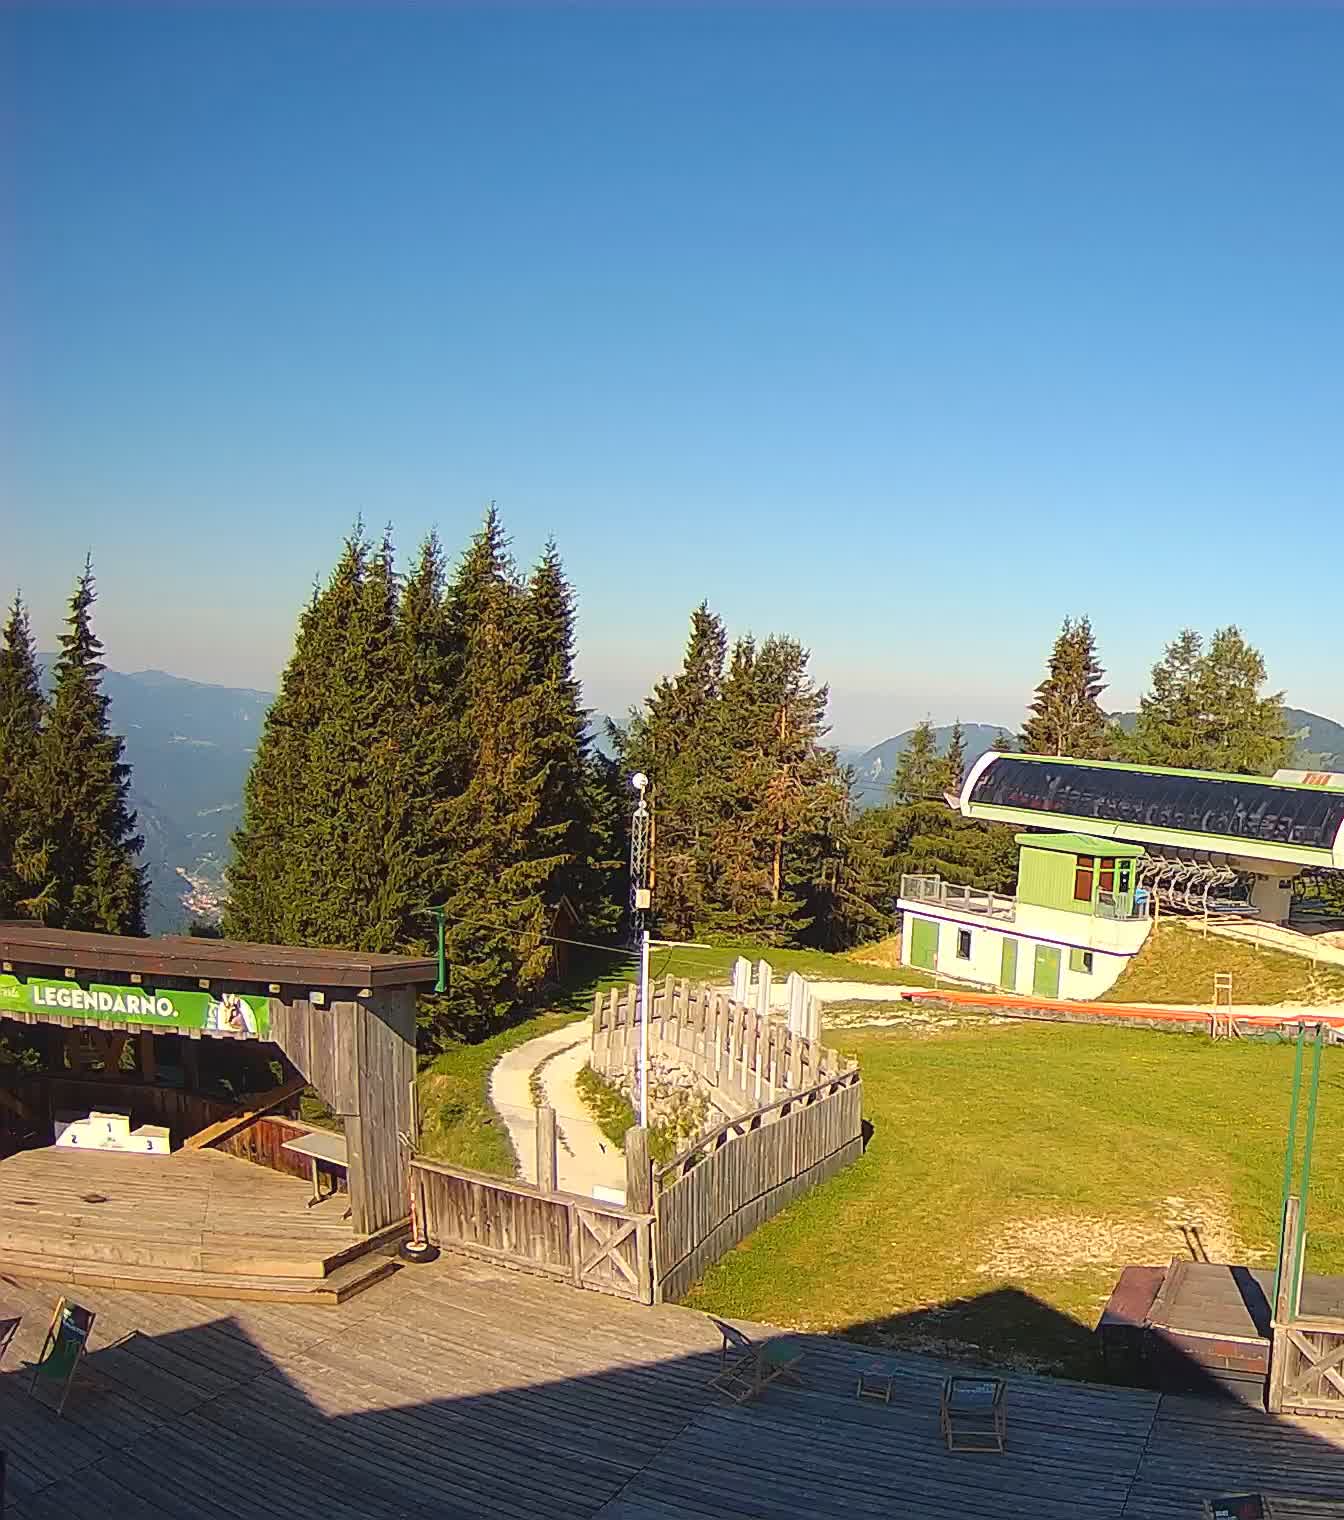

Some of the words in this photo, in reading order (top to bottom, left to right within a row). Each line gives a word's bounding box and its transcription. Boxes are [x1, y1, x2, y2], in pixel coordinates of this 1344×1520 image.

[33, 985, 179, 1018] LEGENDARNO.
[107, 1122, 112, 1133] 1
[71, 1134, 78, 1144] 2
[146, 1140, 153, 1150] 3
